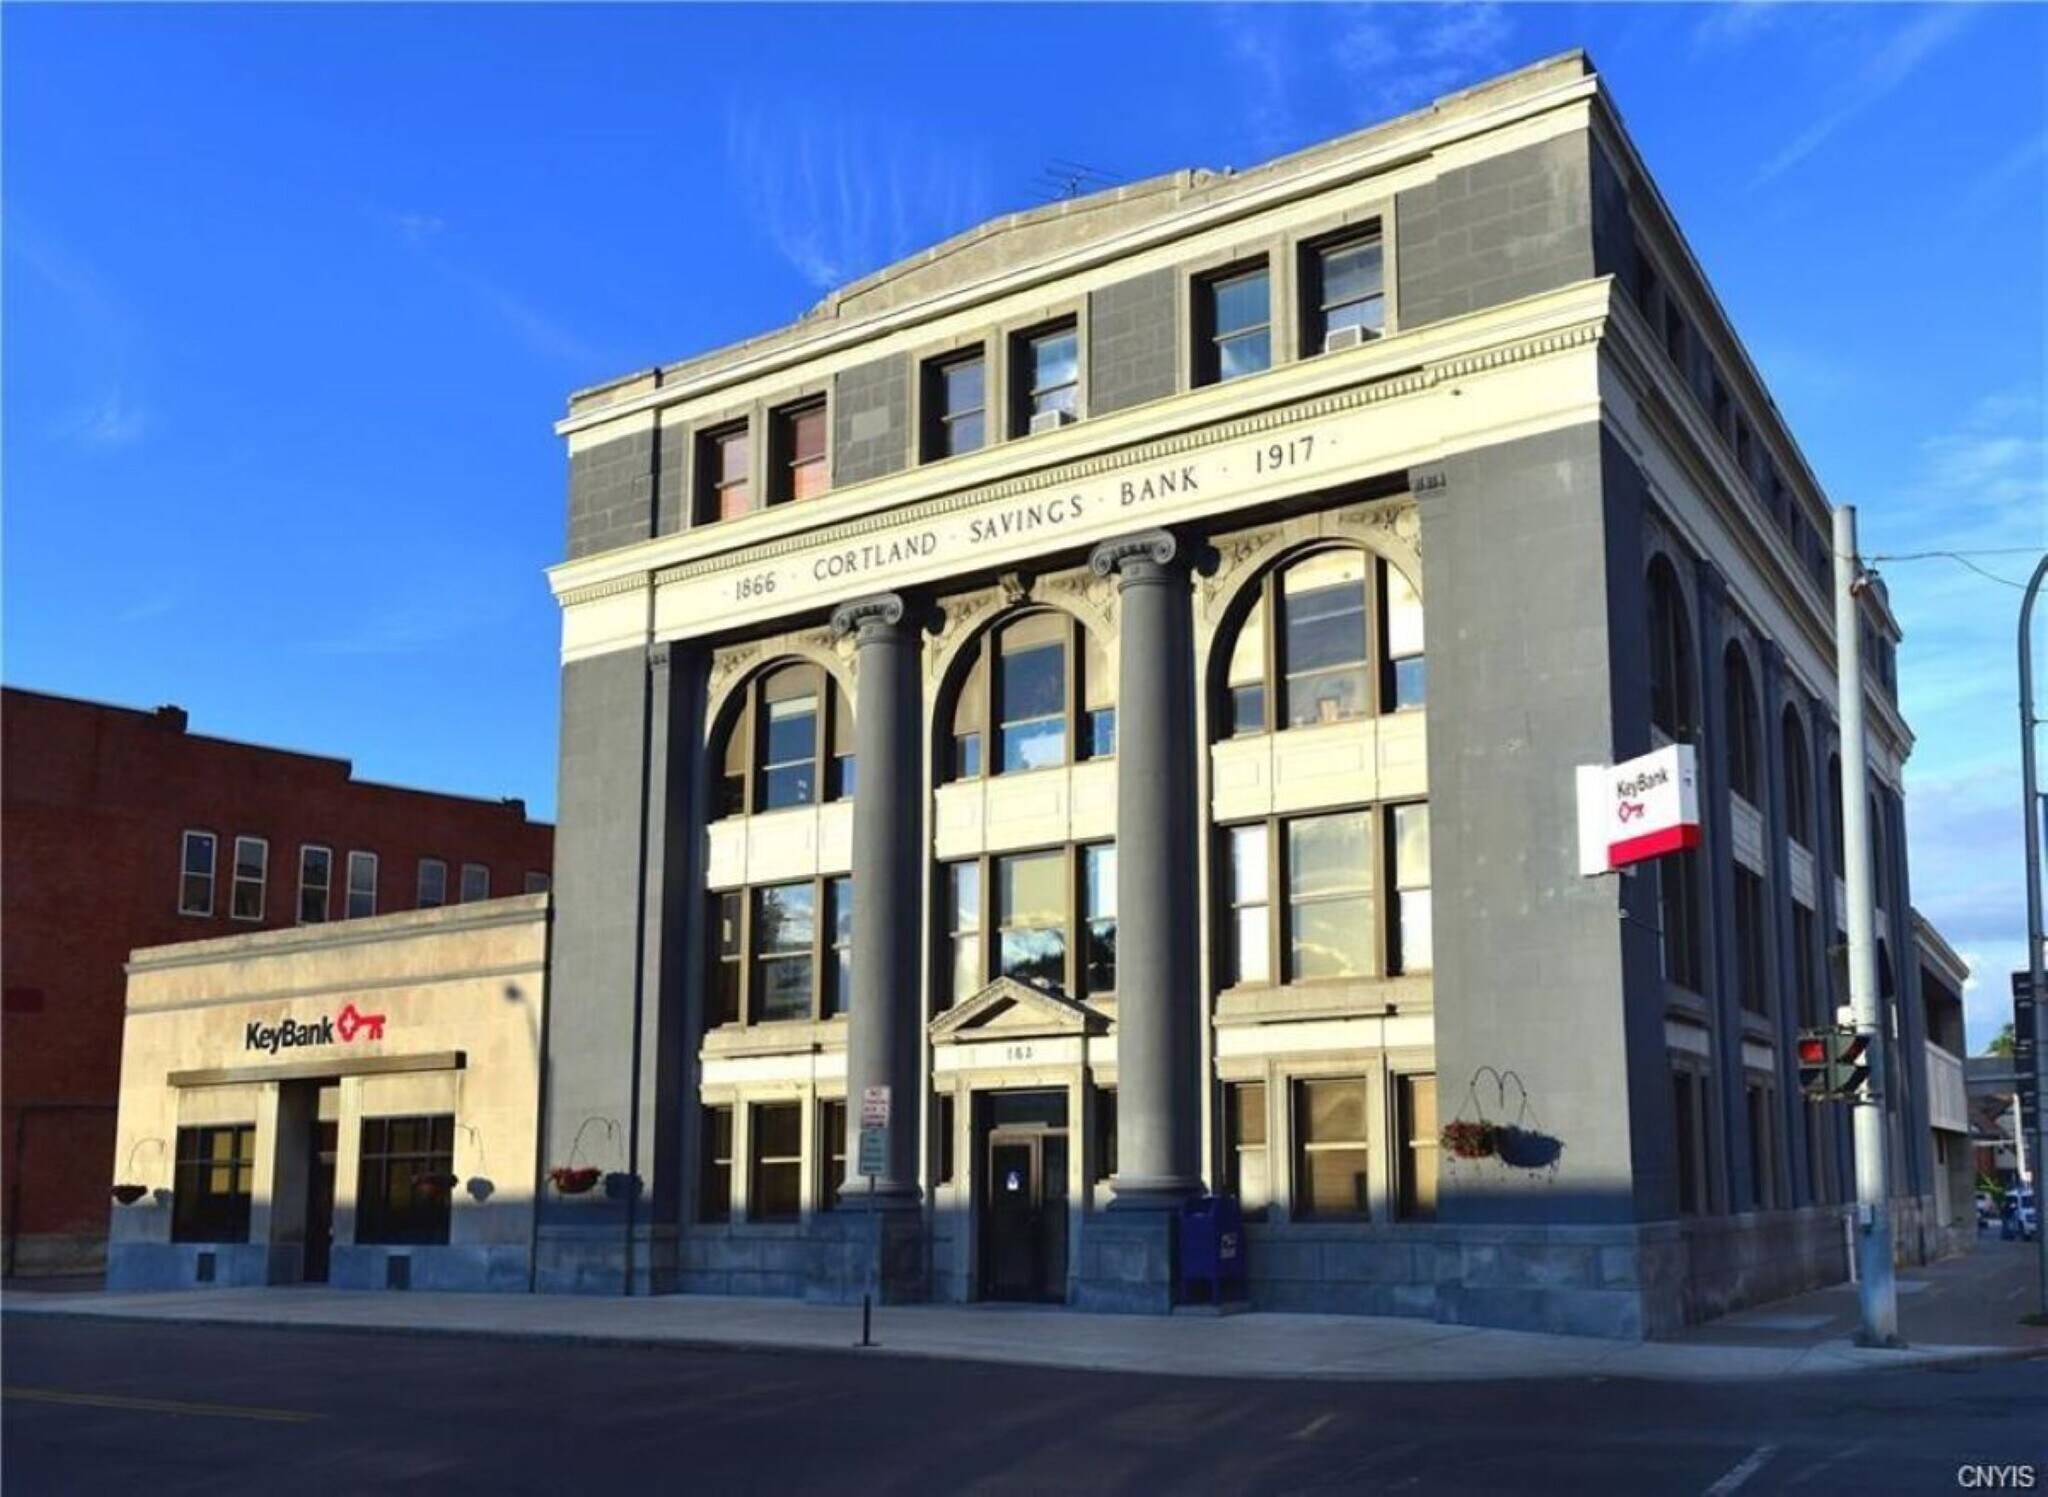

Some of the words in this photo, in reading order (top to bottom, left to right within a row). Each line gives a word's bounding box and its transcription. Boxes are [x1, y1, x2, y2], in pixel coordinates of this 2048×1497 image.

[736, 571, 776, 600] 1866
[813, 532, 937, 581] CORTLAND
[969, 497, 1084, 543] SAVINGS
[1120, 466, 1199, 506] BANK
[1256, 435, 1315, 474] 1917
[1617, 767, 1669, 798] KeyBank
[245, 1015, 334, 1054] KeyBank
